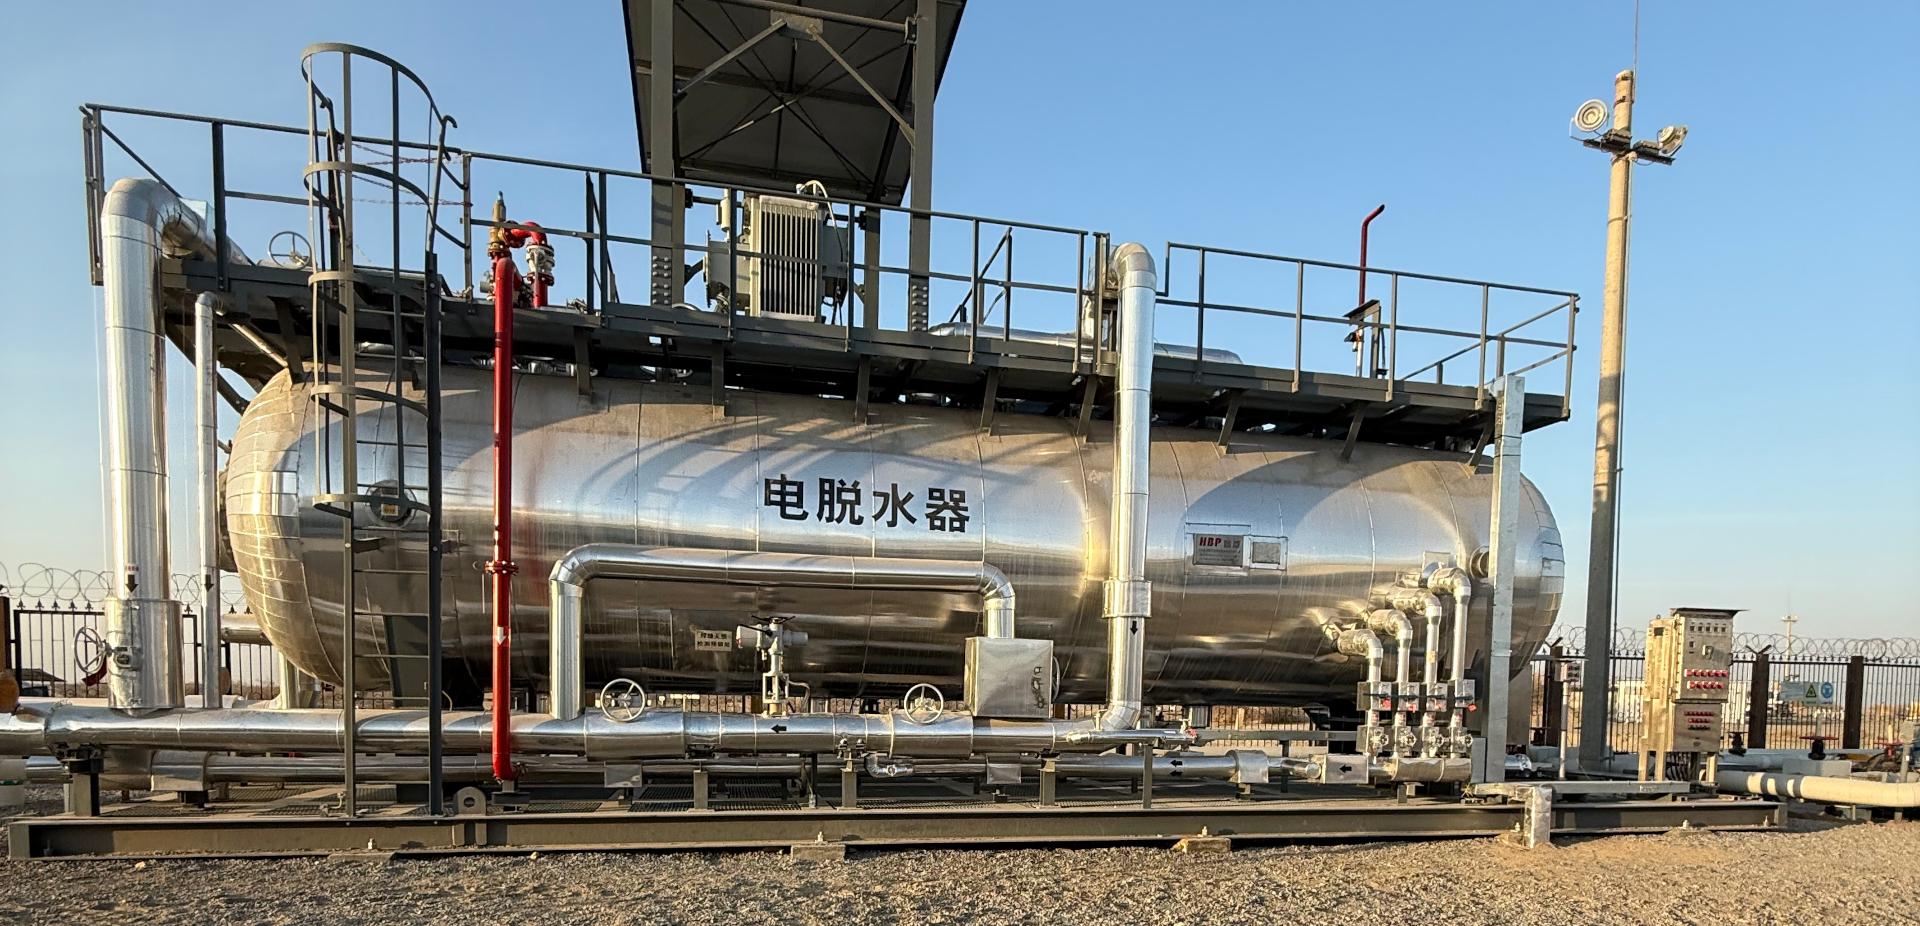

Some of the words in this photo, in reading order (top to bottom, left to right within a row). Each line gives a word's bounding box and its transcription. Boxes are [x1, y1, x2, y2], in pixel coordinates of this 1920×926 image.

[764, 473, 970, 533] 电脱水器
[1199, 537, 1221, 547] HBP
